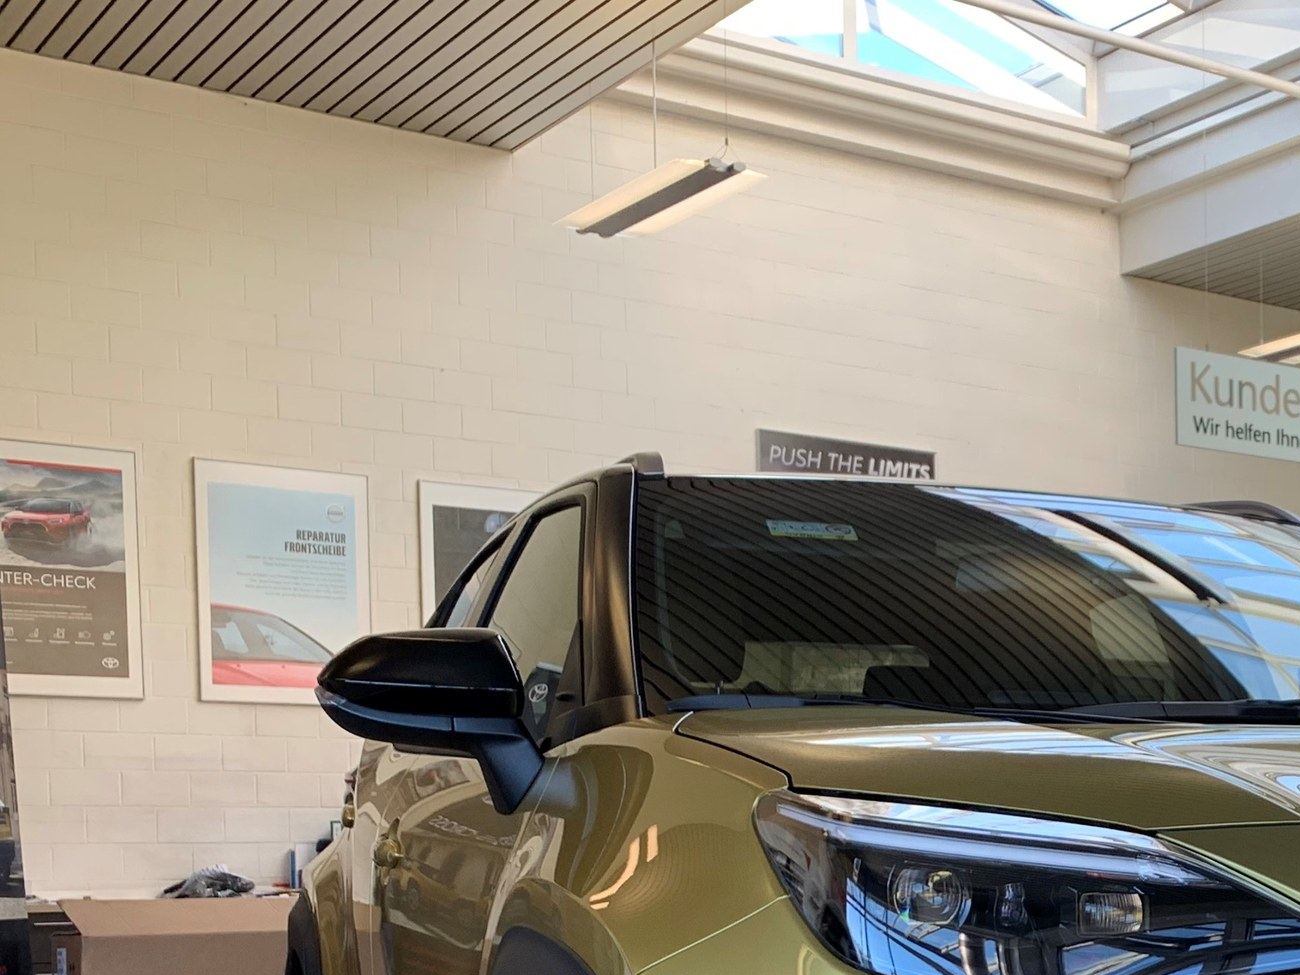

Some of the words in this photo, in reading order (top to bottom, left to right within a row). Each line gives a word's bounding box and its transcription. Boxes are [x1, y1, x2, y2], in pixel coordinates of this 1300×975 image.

[1192, 415, 1221, 436] Wir
[1225, 419, 1271, 445] helfen
[768, 444, 823, 470] PUSH
[827, 452, 864, 475] THE
[867, 457, 932, 480] LIMITS
[296, 529, 347, 544] REPARATUR
[284, 541, 347, 556] FRONTSCHEIBE
